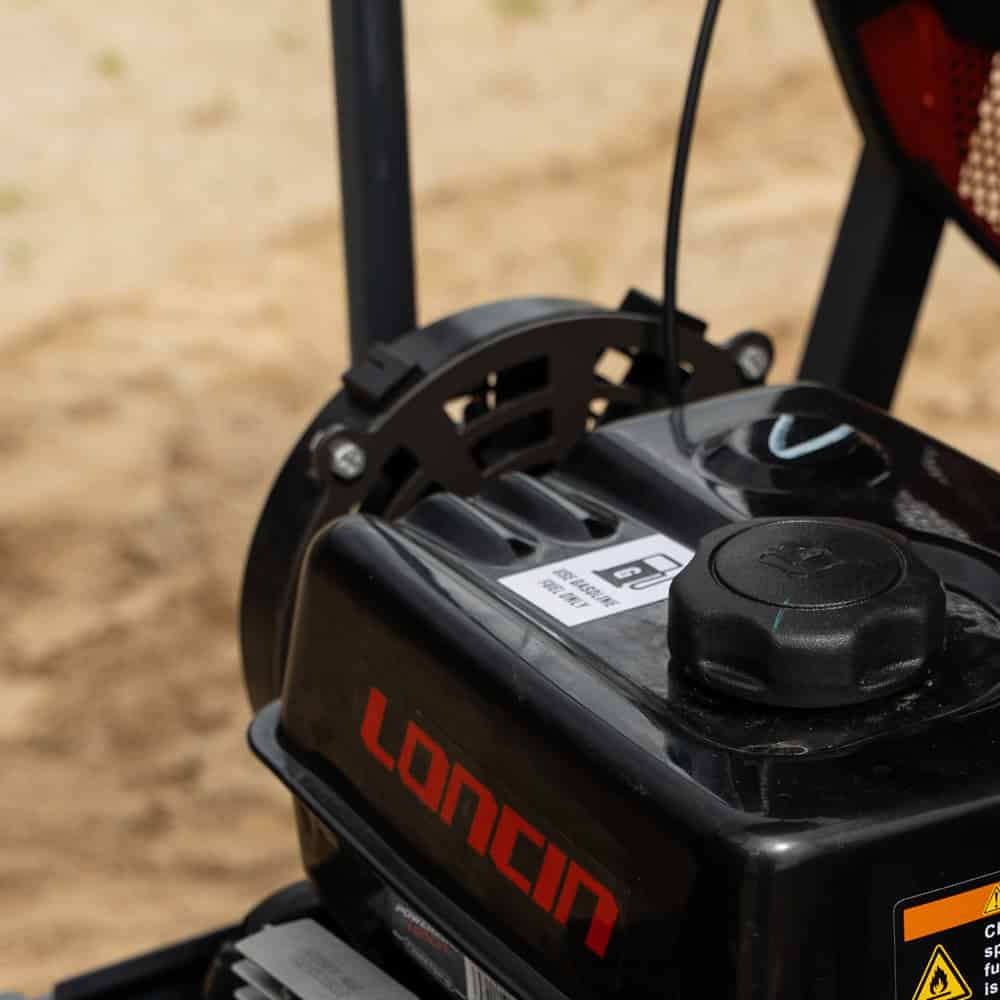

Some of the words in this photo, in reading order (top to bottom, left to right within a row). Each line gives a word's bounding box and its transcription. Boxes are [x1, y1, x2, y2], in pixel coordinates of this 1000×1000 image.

[556, 591, 591, 609] ONLY
[567, 577, 621, 608] GASOLINE
[985, 982, 998, 996] is
